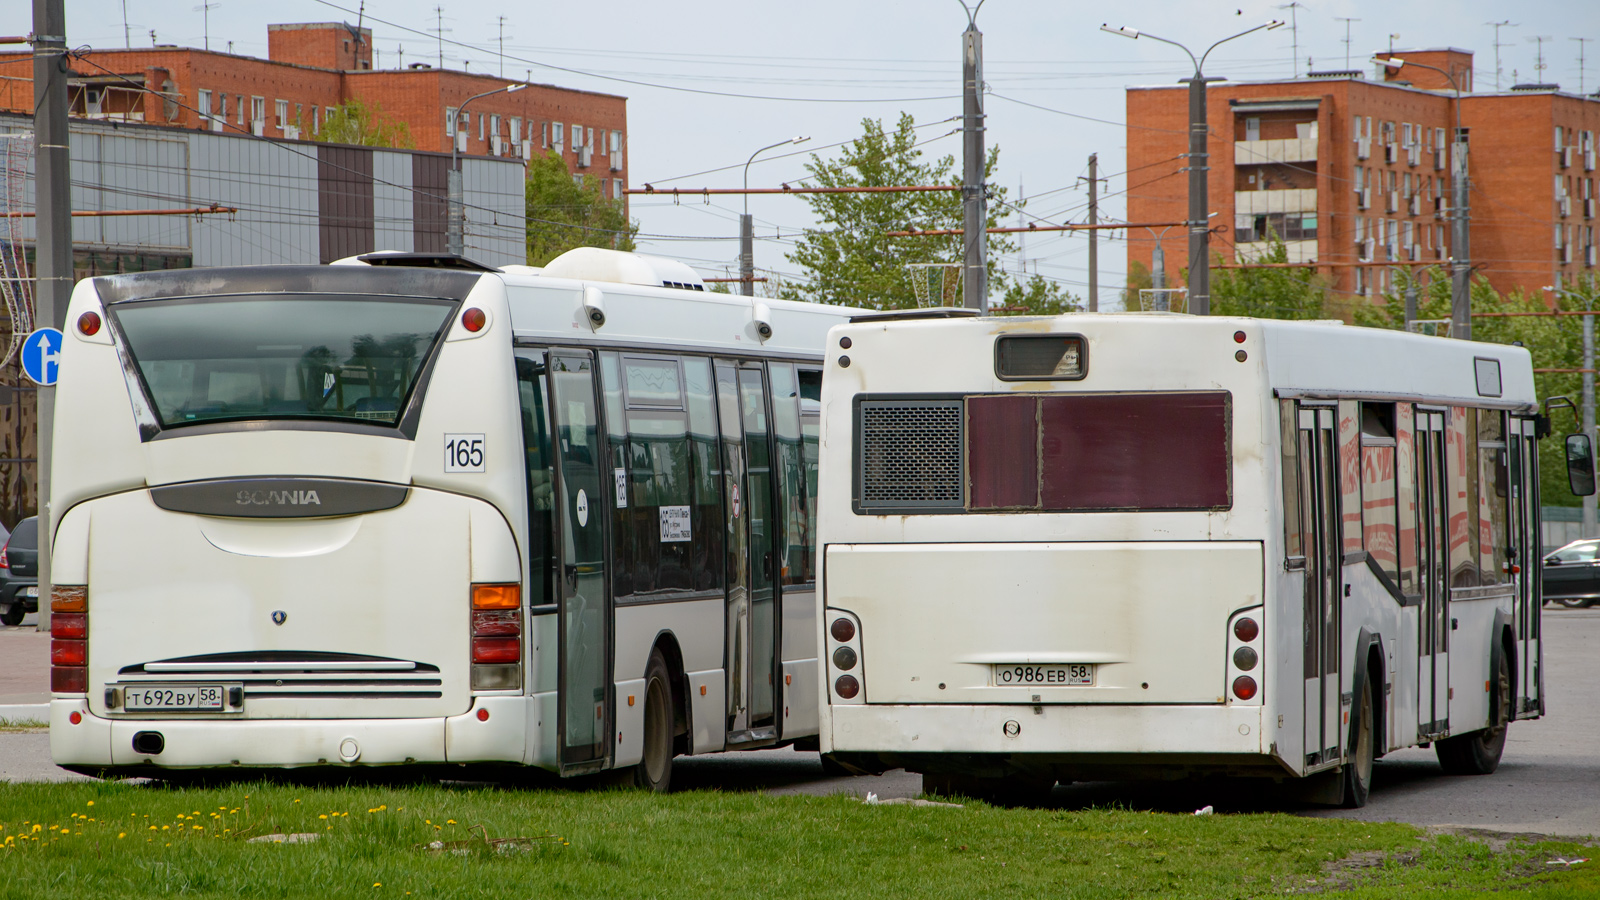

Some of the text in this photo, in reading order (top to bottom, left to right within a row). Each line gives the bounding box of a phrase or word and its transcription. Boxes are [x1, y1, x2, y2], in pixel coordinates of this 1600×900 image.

[446, 439, 483, 467] 165
[235, 490, 321, 505] SCANIA
[1002, 666, 1087, 682] О986ЕВ 58
[132, 689, 216, 706] Т692ВУ 58
